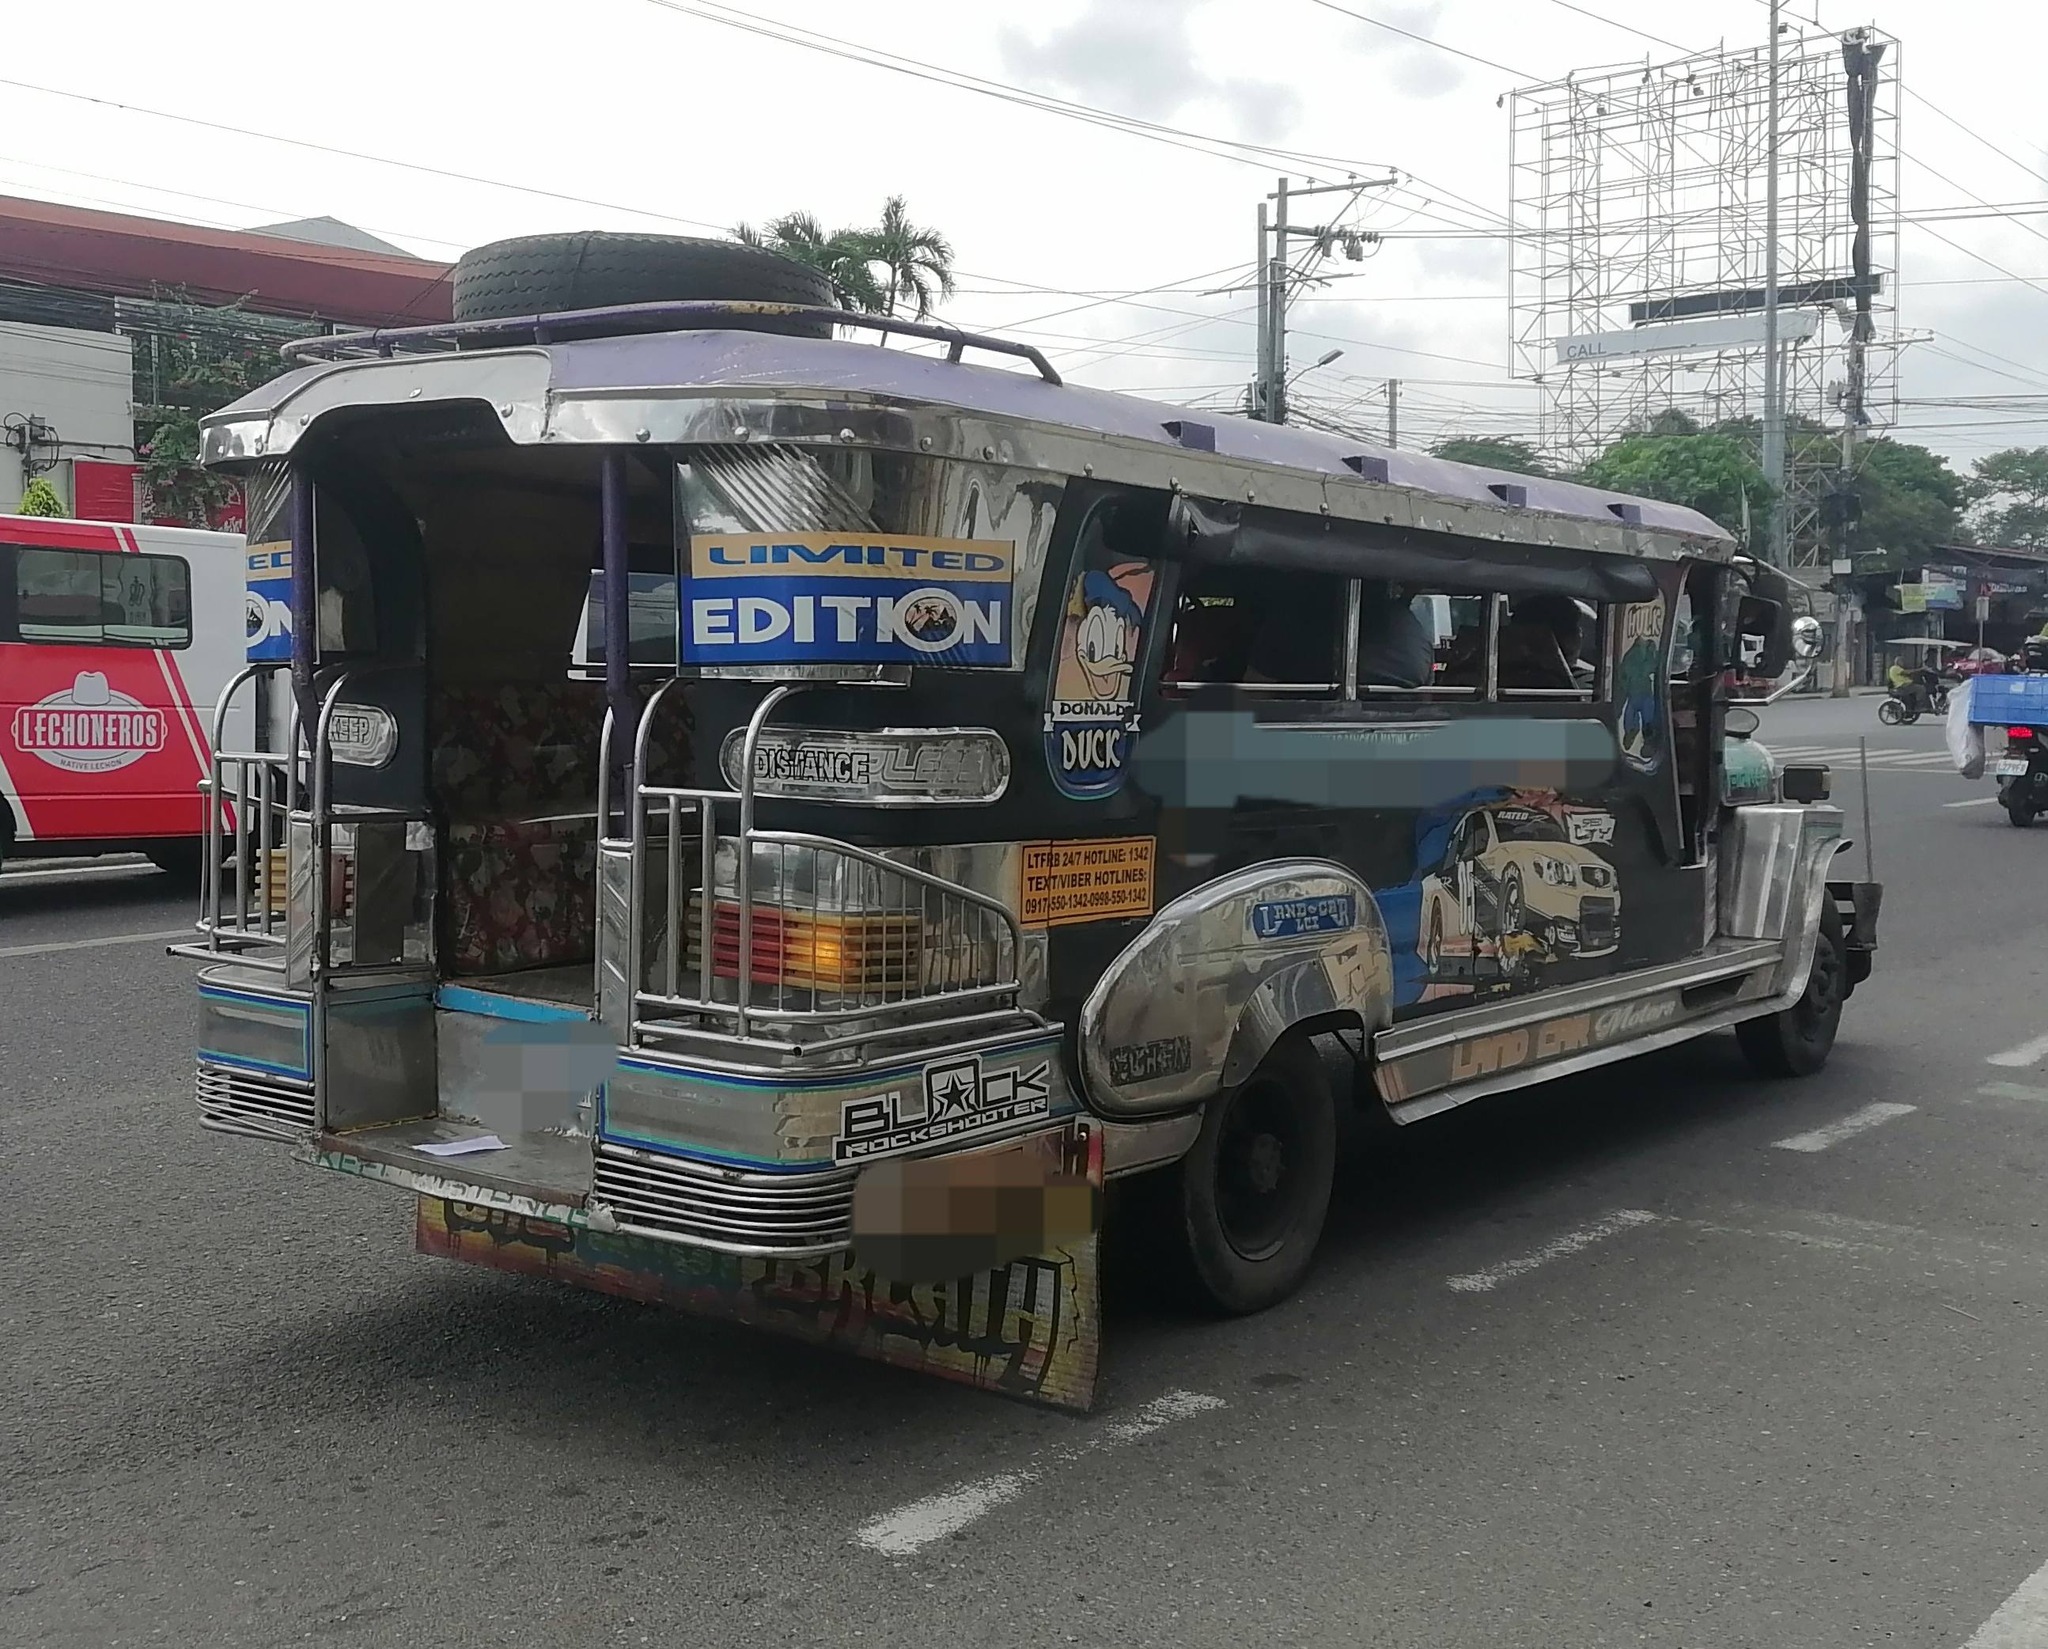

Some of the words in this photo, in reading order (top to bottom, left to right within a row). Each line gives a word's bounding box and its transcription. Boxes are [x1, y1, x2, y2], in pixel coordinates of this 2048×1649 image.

[1567, 342, 1607, 358] CALL
[709, 544, 1005, 573] LIMITED
[692, 587, 1001, 653] EDITION
[1627, 606, 1661, 637] HULK
[1060, 702, 1125, 716] DONALD
[23, 713, 157, 747] LECHONEROS
[60, 758, 88, 770] NATIVE
[90, 759, 122, 770] LECHON
[1061, 728, 1121, 771] DUCK
[754, 748, 870, 785] DISTANCE
[1497, 811, 1529, 820] RATED
[1027, 851, 1060, 869] LTFRB
[1062, 851, 1082, 868] 24/7
[1084, 848, 1126, 866] HOTLINE:
[1129, 846, 1149, 862] 1342
[1028, 872, 1091, 892] TEXT/VIBER
[1095, 868, 1147, 886] HOTLINES:
[845, 1099, 1047, 1158] ROCKSHOOTER
